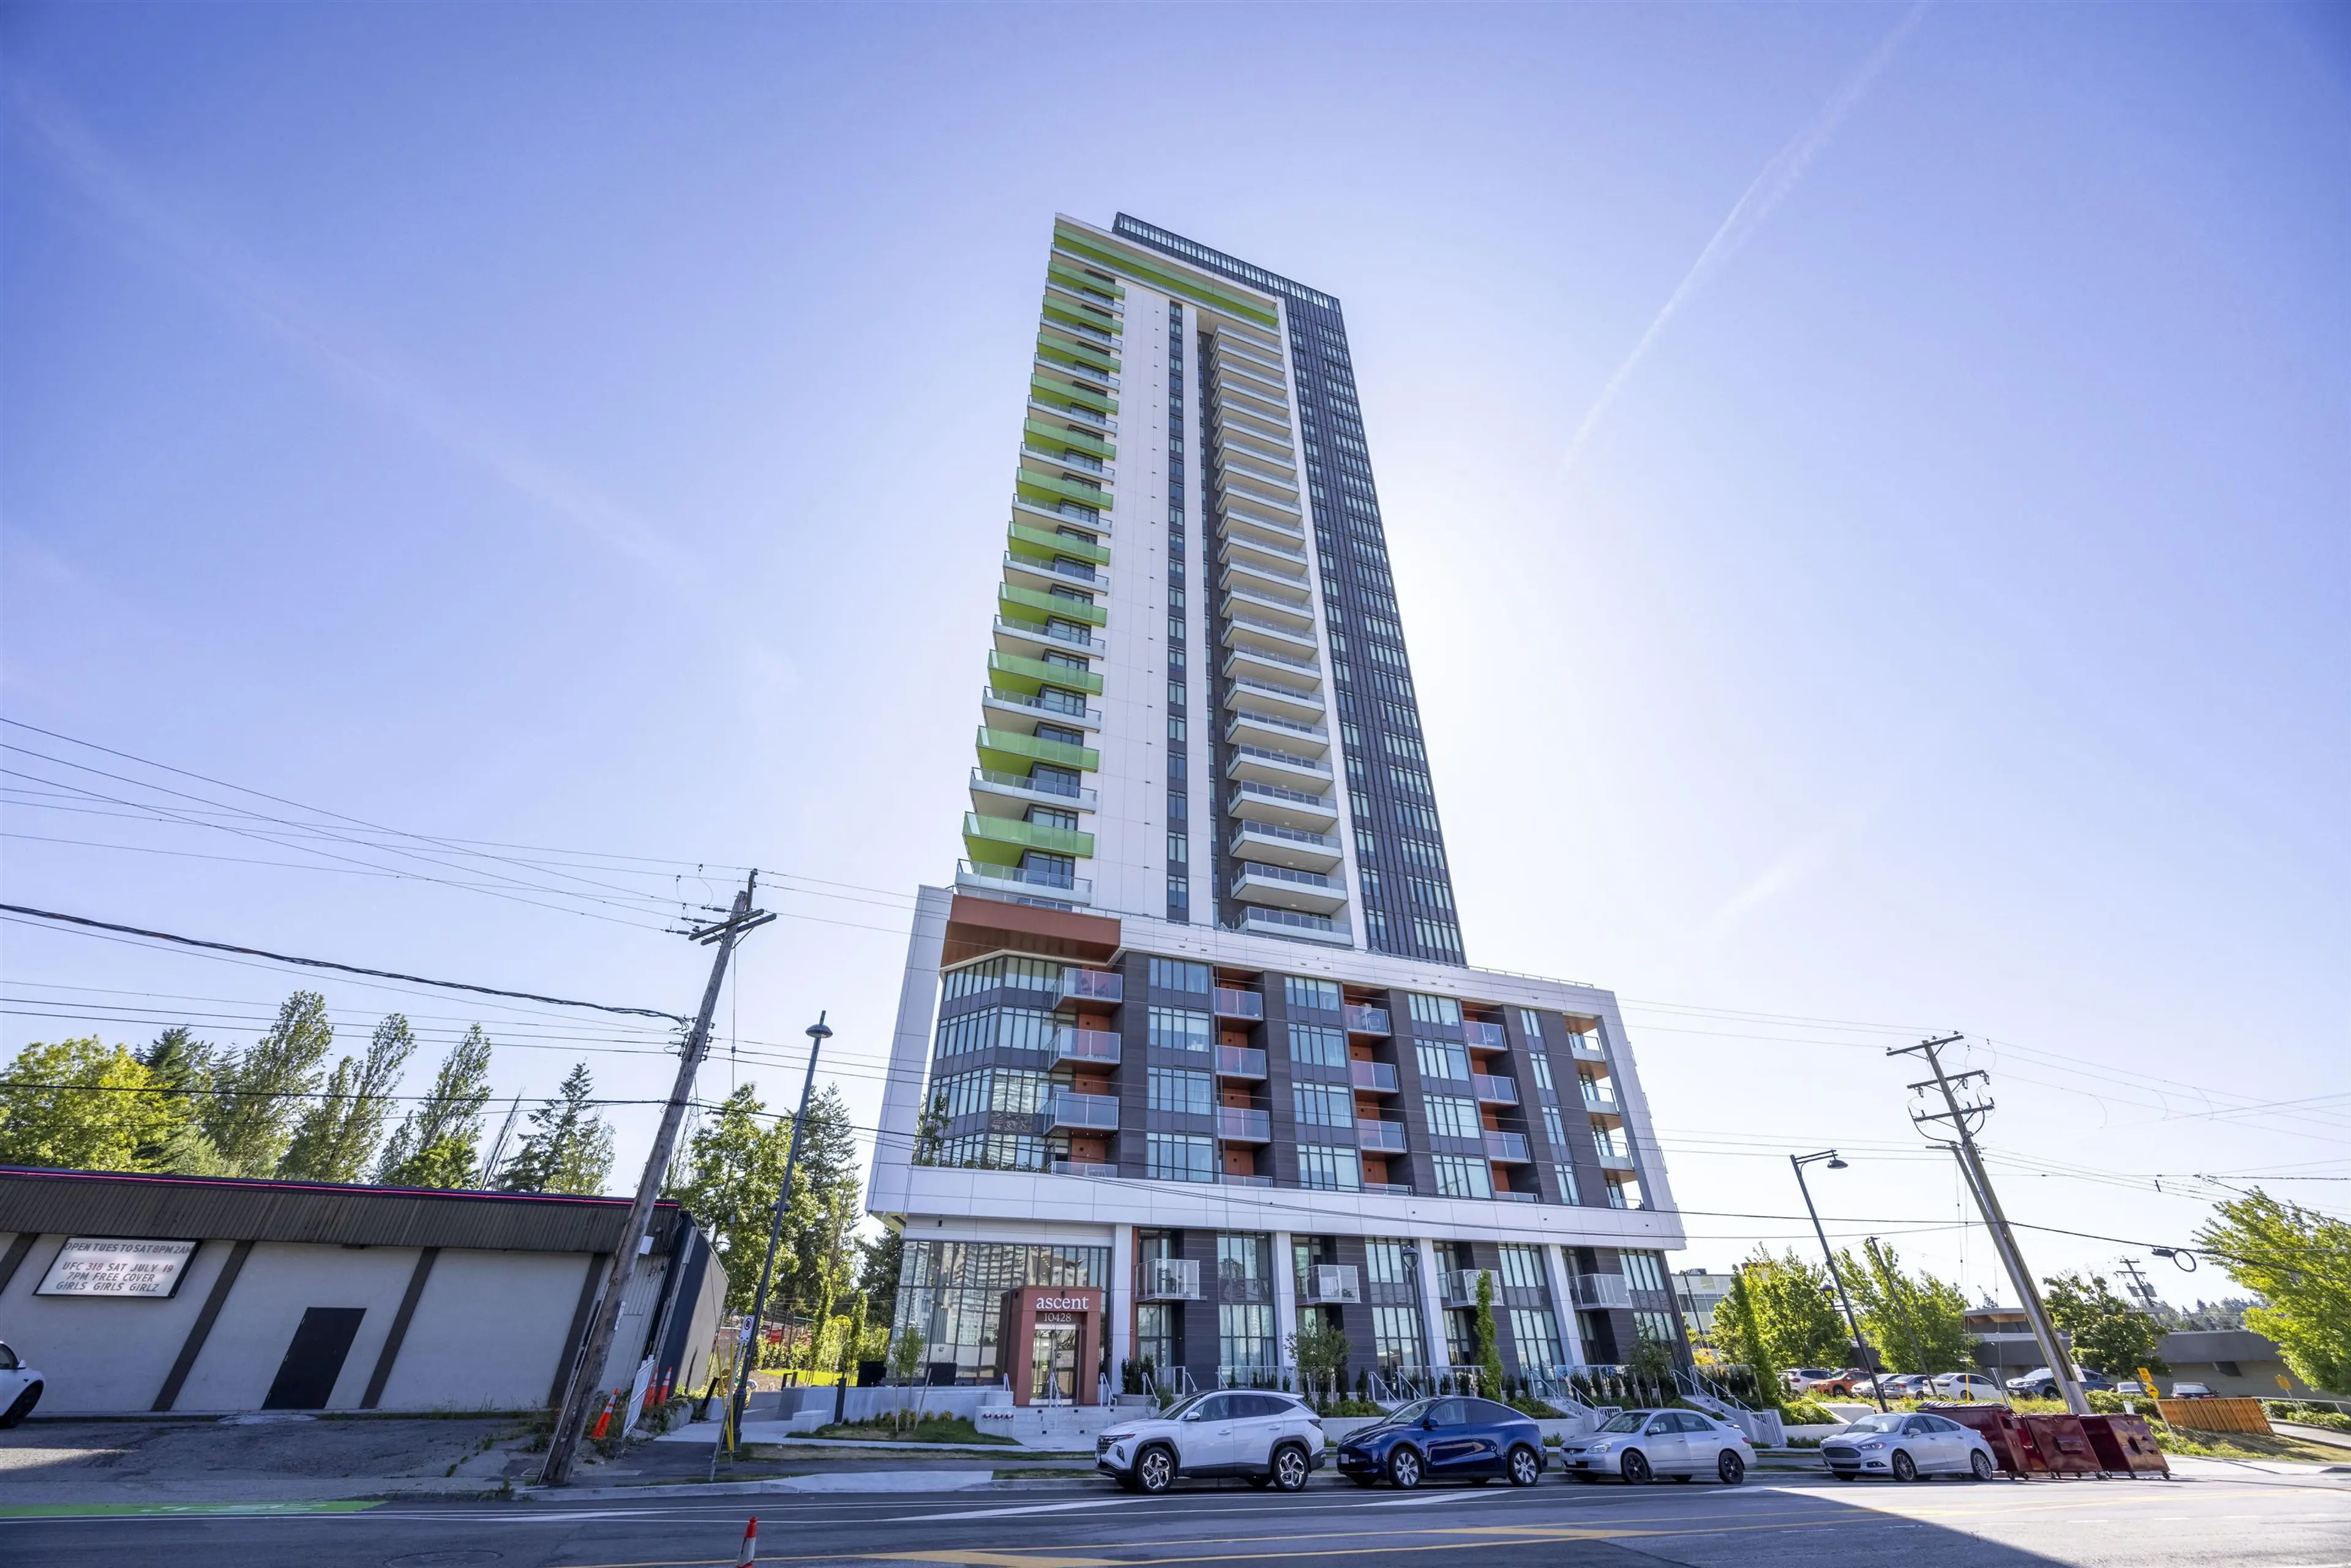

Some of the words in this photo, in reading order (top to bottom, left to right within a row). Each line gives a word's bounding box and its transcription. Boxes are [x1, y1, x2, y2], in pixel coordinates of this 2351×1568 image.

[92, 1243, 119, 1252] TUES
[120, 1244, 133, 1253] TO
[133, 1244, 154, 1253] SAT
[152, 1245, 174, 1254] 8PM
[62, 1261, 84, 1270] UFC
[85, 1262, 103, 1271] 318
[107, 1262, 127, 1272] SAT
[130, 1263, 159, 1272] JULY
[162, 1264, 174, 1273] 19
[66, 1272, 90, 1281] 7PM
[92, 1272, 120, 1281] FREE
[122, 1273, 155, 1282] COVER
[56, 1281, 88, 1291] GIRLS
[93, 1282, 125, 1291] GIRLS
[1036, 1296, 1089, 1310] ascent
[1044, 1312, 1071, 1322] 10428
